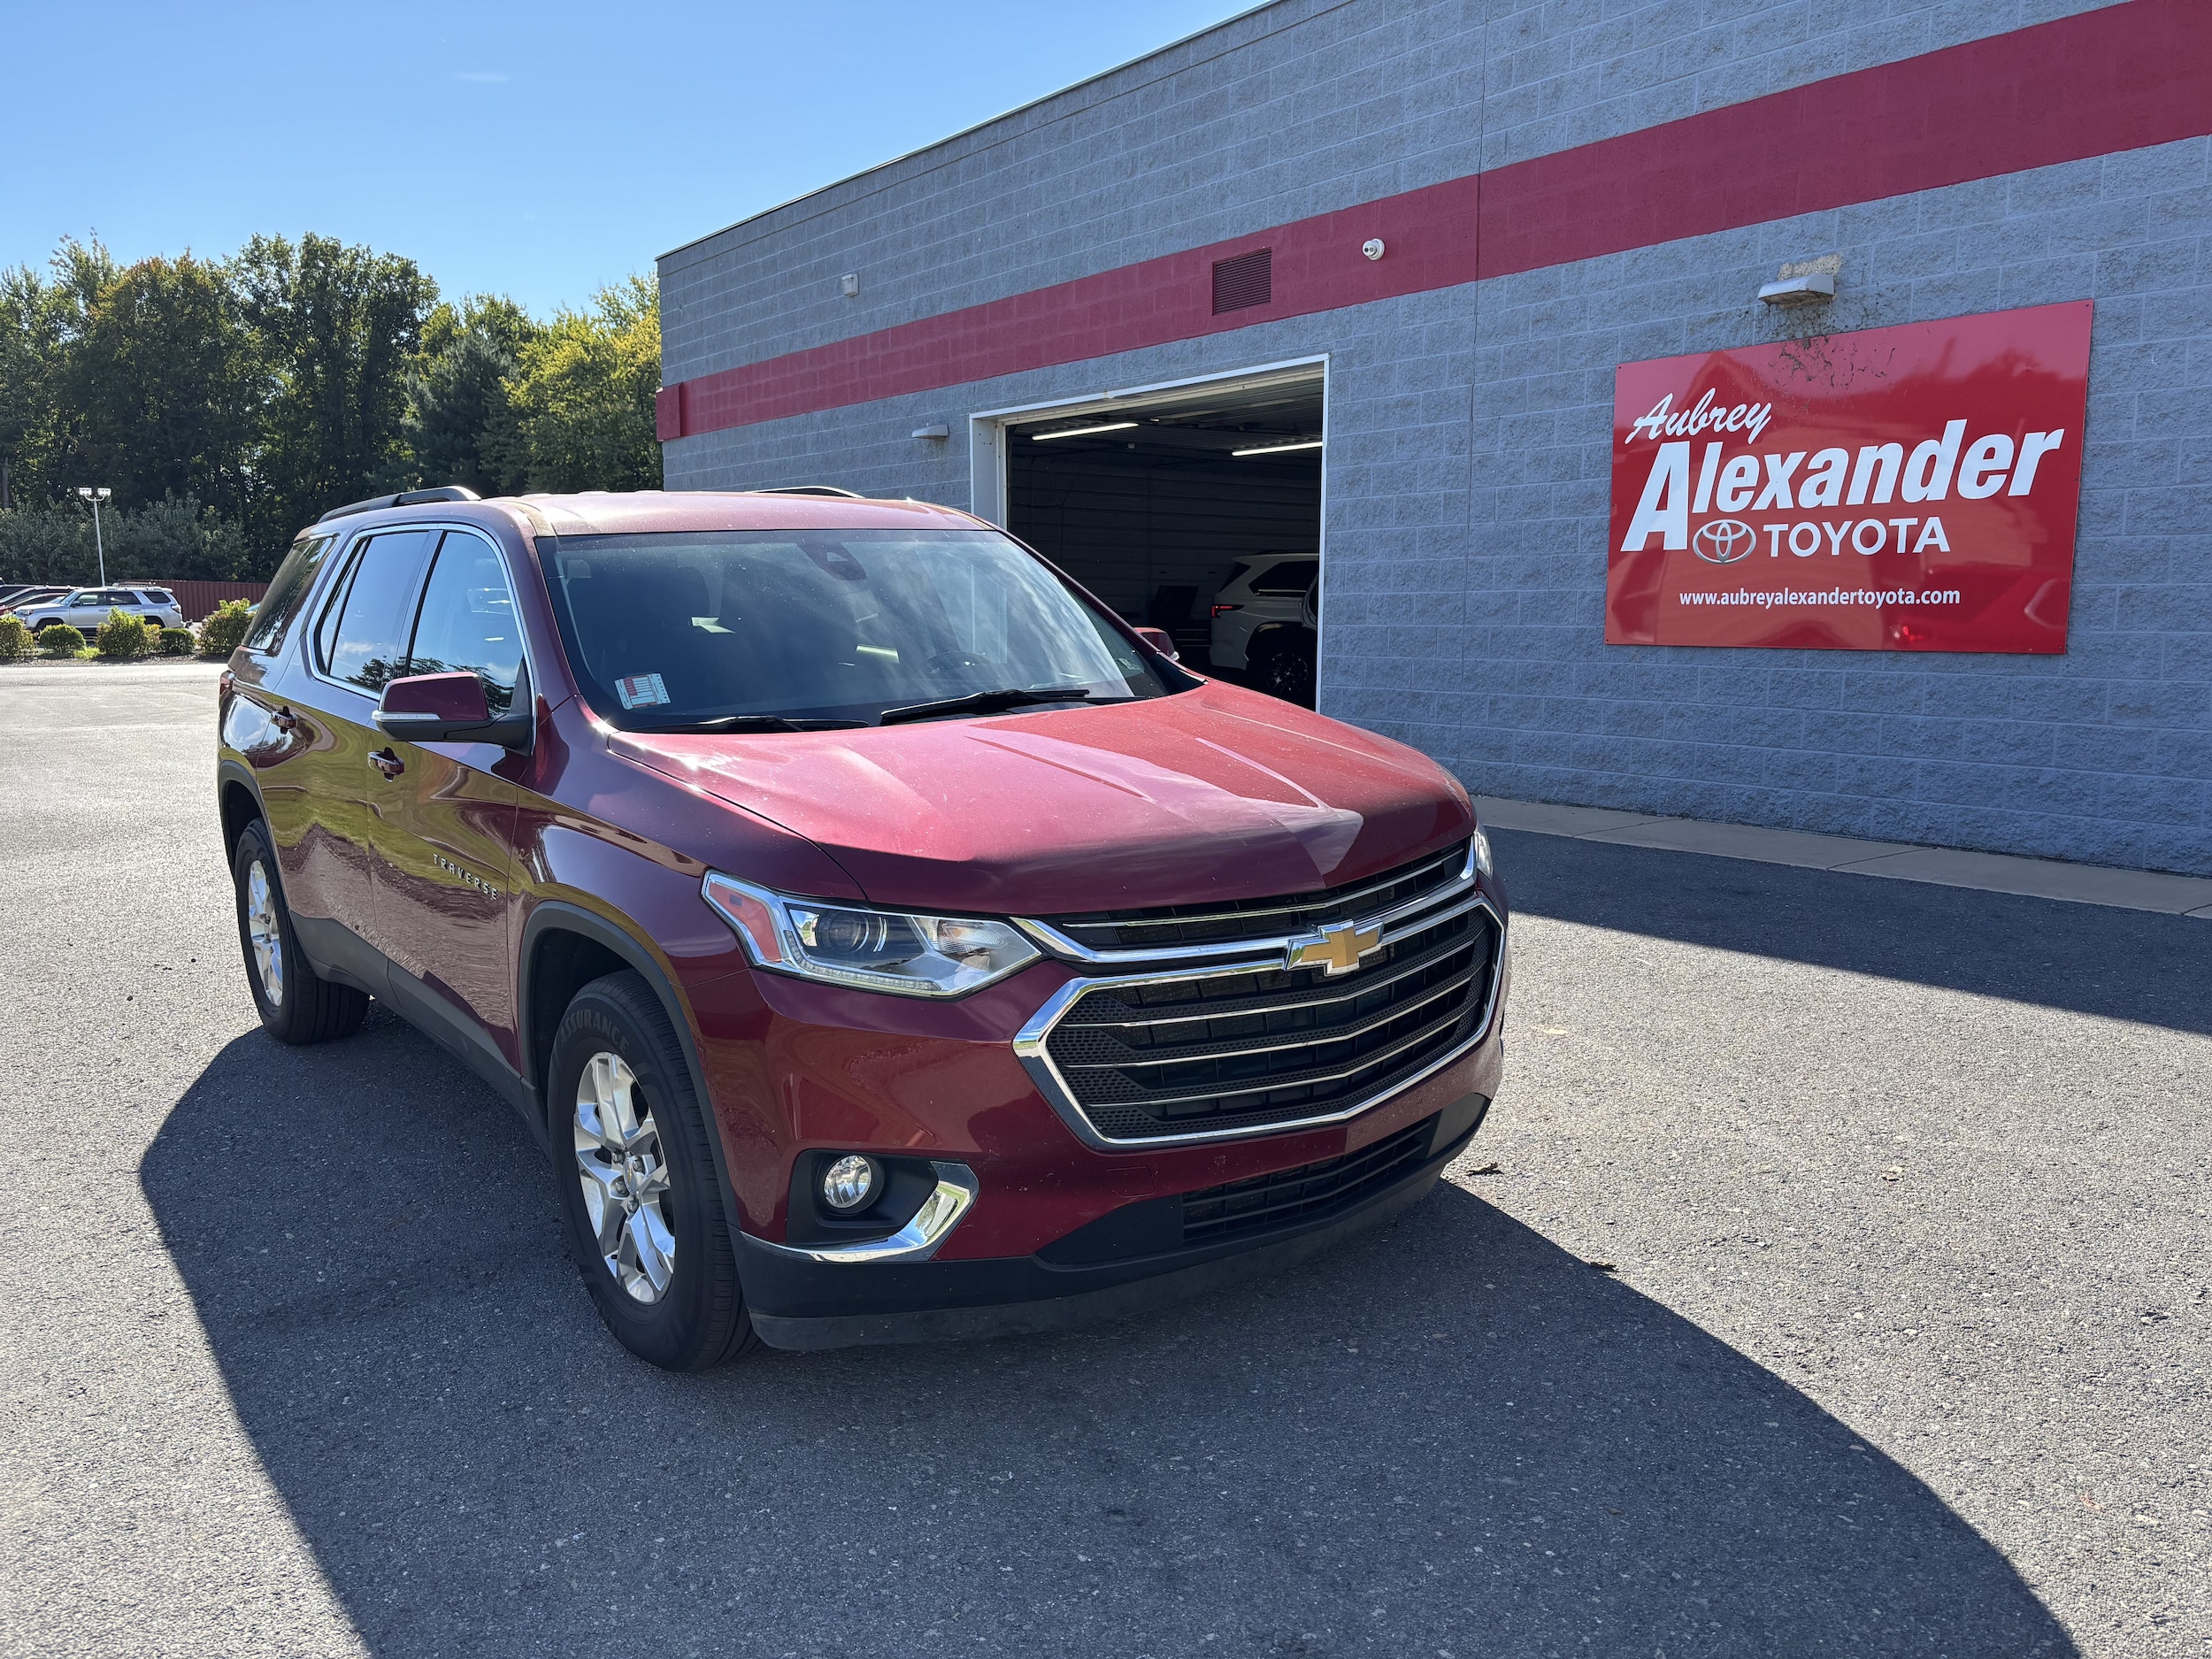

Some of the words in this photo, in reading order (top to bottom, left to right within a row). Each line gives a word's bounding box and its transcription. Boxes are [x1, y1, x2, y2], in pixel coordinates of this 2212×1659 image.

[1625, 388, 1771, 443] Aubrey
[1621, 419, 2065, 551] Alexander
[1763, 517, 1951, 557] TOYOTA
[1679, 588, 1961, 609] www.aubreyalexandertoyota.com
[433, 853, 498, 900] TRAVERSE
[560, 1009, 630, 1056] ASSURANCE
